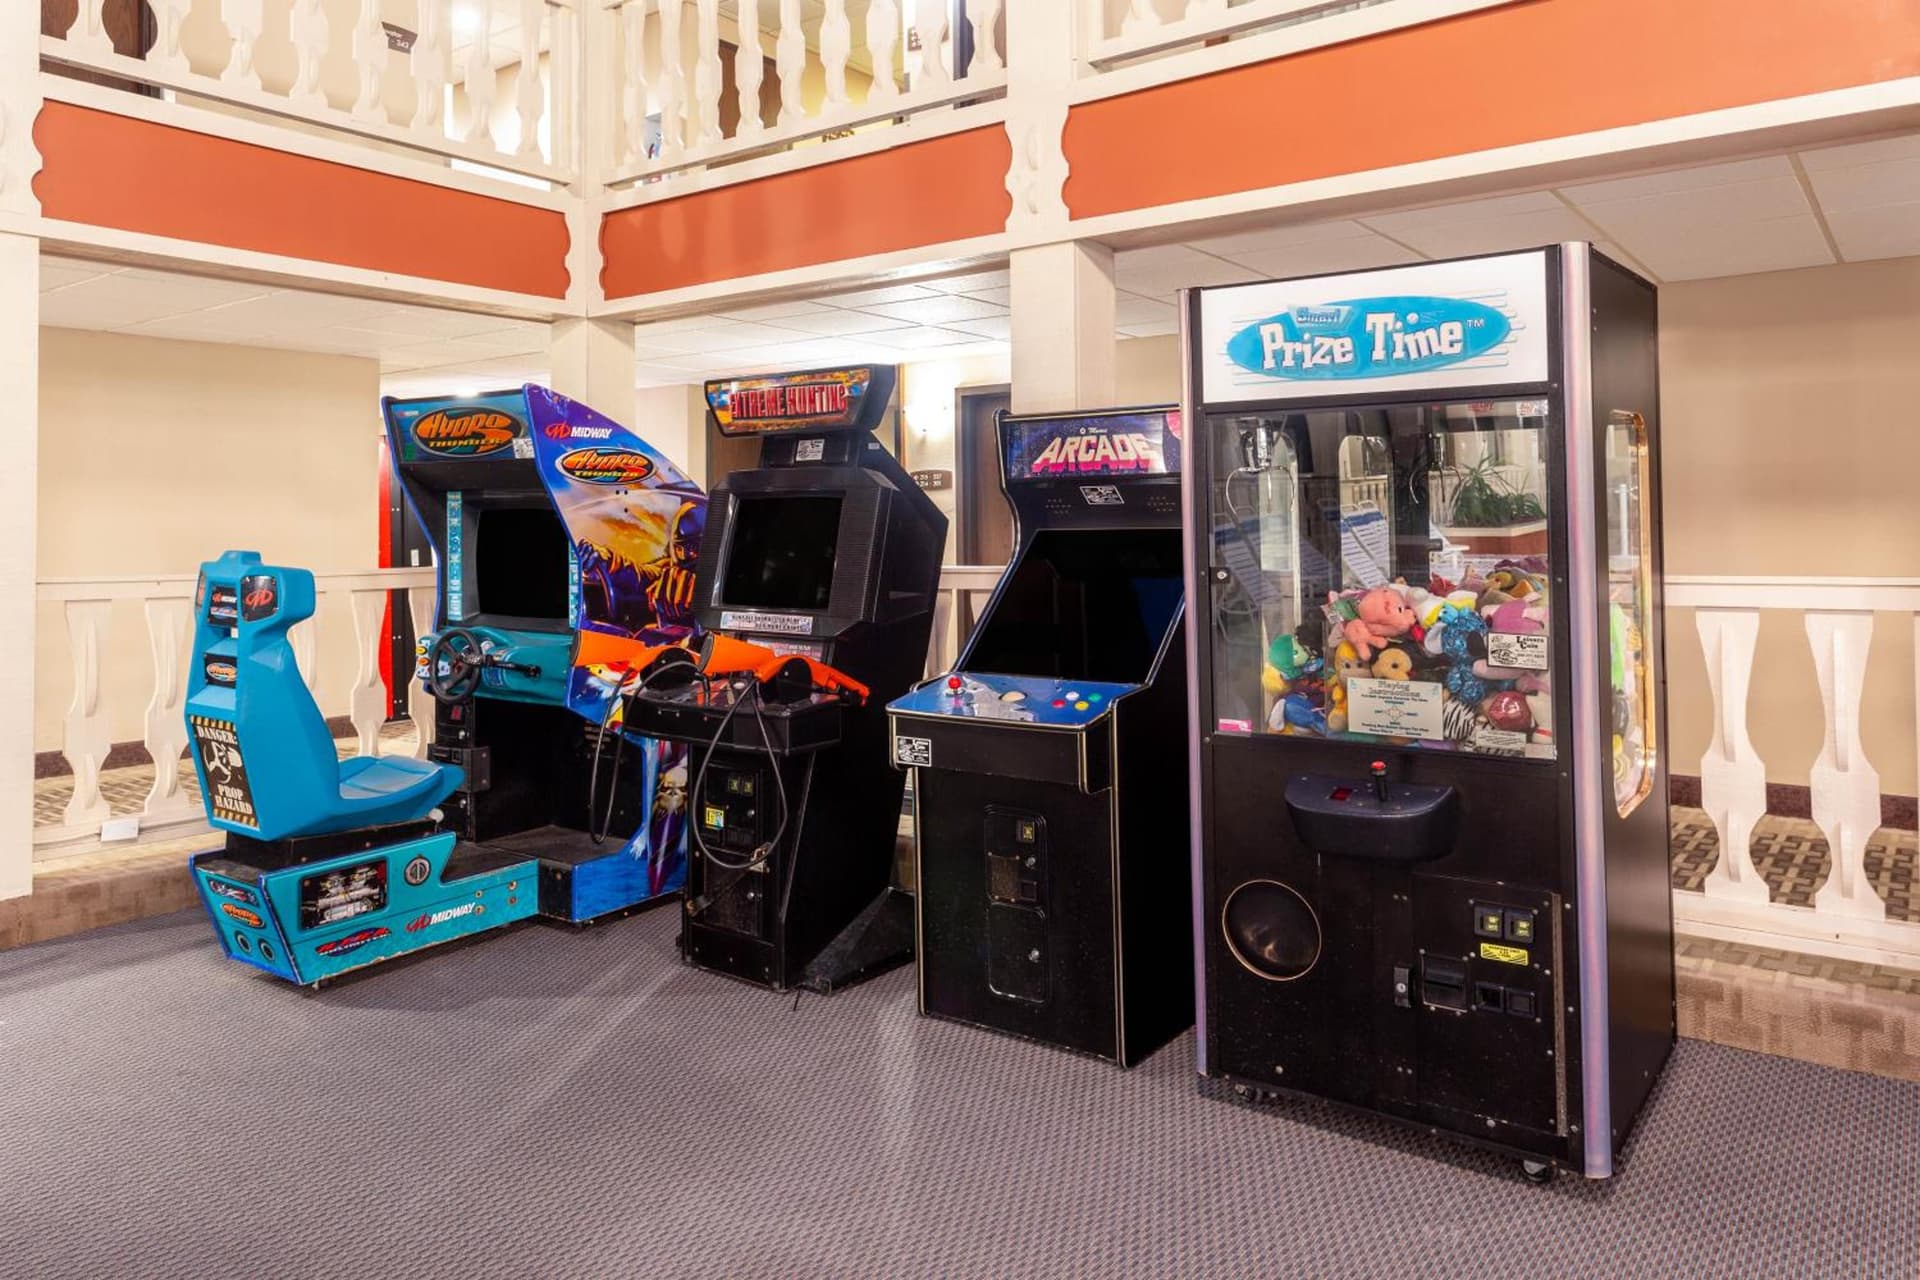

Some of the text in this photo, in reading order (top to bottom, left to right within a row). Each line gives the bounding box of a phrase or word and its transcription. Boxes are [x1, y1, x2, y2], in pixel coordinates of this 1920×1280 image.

[1259, 311, 1484, 371] Prize Time TM
[729, 383, 848, 419] EXTREME HUNTING
[429, 438, 502, 448] THUNDER
[571, 426, 612, 439] MIDWAY
[1032, 433, 1156, 473] ARCADE
[217, 784, 243, 800] PROP
[214, 794, 254, 815] HAZARD
[430, 902, 475, 925] MIDWAY
